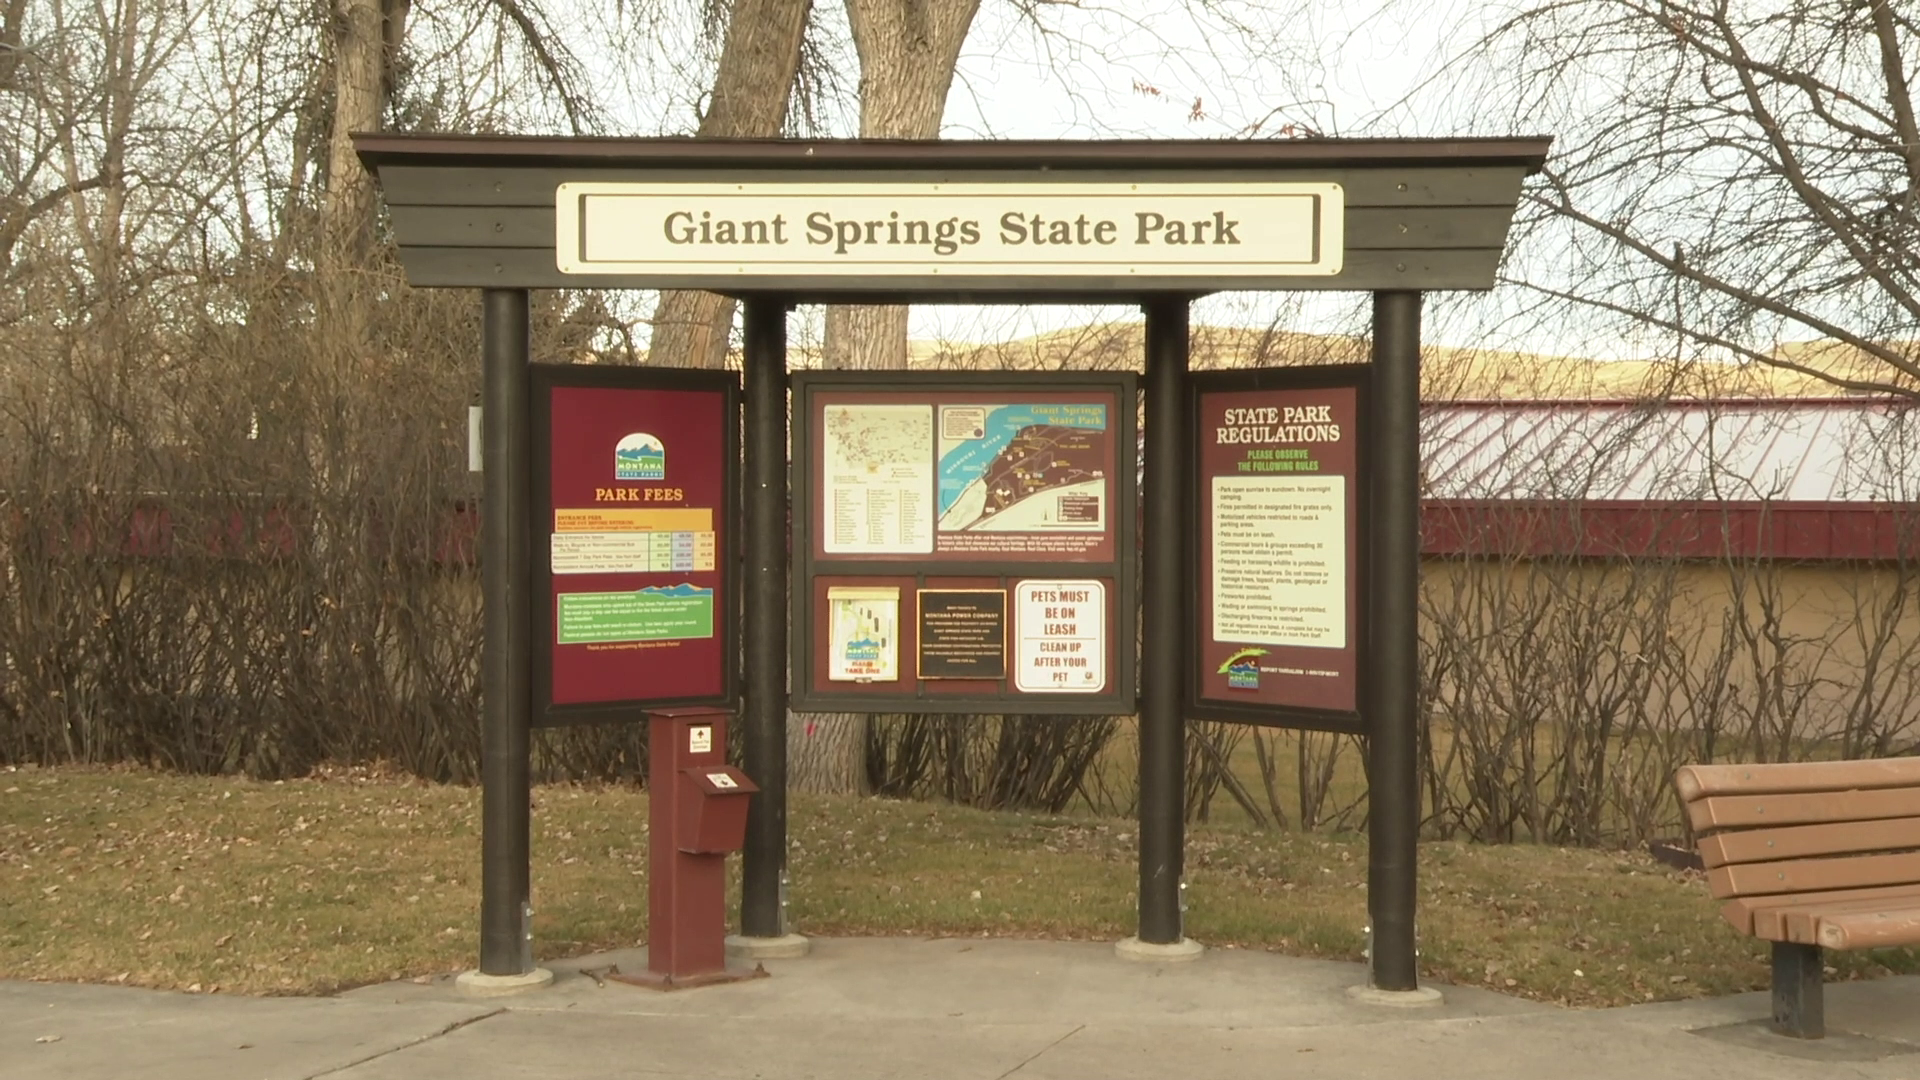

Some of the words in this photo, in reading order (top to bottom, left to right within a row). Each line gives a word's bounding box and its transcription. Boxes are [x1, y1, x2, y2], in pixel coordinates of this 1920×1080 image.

[664, 210, 788, 245] Giant
[806, 210, 980, 256] Springs
[1000, 211, 1117, 245] State
[1134, 210, 1240, 245] Park
[1031, 406, 1058, 414] Giant
[1063, 406, 1102, 416] Springs
[1224, 408, 1279, 425] STATE
[1283, 406, 1332, 423] PARK
[1048, 416, 1074, 424] State
[1078, 416, 1102, 424] Park
[1216, 424, 1340, 444] REGULATIONS
[1247, 450, 1273, 459] PLEASE
[1275, 449, 1308, 459] OBSERVE
[1238, 462, 1251, 471] THE
[1253, 461, 1293, 471] FOLLOWING
[1295, 461, 1319, 471] RULES
[596, 488, 639, 501] PARK
[644, 488, 683, 501] FEES
[1031, 591, 1056, 602] PETS
[1059, 591, 1089, 602] MUST
[1045, 607, 1058, 618] BE
[1061, 607, 1075, 618] ON
[1044, 624, 1076, 635] LEASH
[1040, 642, 1067, 652] CLEAN
[1069, 642, 1081, 652] UP
[1034, 657, 1060, 667] AFTER
[1063, 657, 1086, 667] YOUR
[1053, 672, 1068, 682] PET
